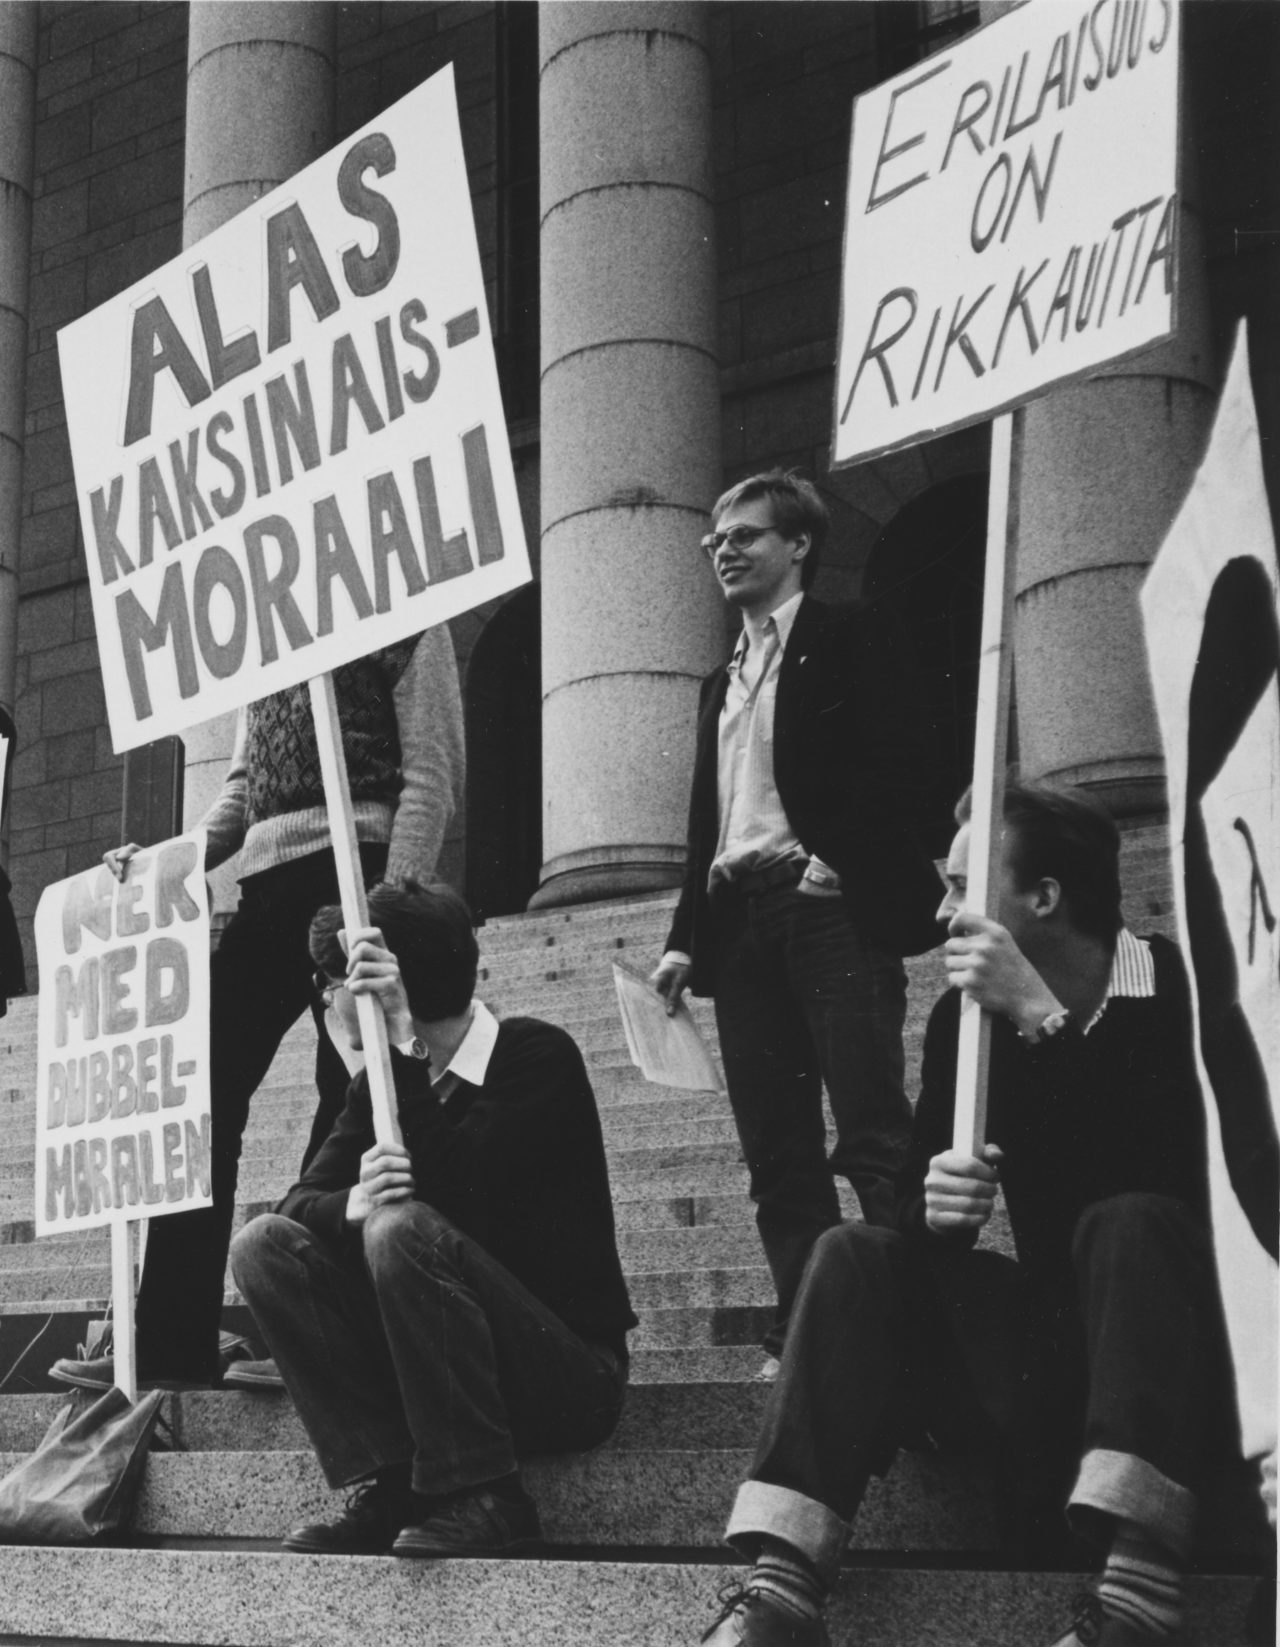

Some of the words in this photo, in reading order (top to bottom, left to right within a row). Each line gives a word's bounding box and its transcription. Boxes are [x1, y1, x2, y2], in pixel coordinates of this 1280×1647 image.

[970, 129, 1064, 254] ON
[120, 130, 401, 448] ALAS
[839, 193, 1178, 425] RIKKAUTTA
[86, 296, 481, 586] KAKSINAIS-
[113, 419, 505, 722] MORAALI
[62, 841, 201, 955] NER
[55, 936, 190, 1048] MED
[47, 1034, 197, 1130] DUBBEL-
[45, 1112, 211, 1222] MORALEN
